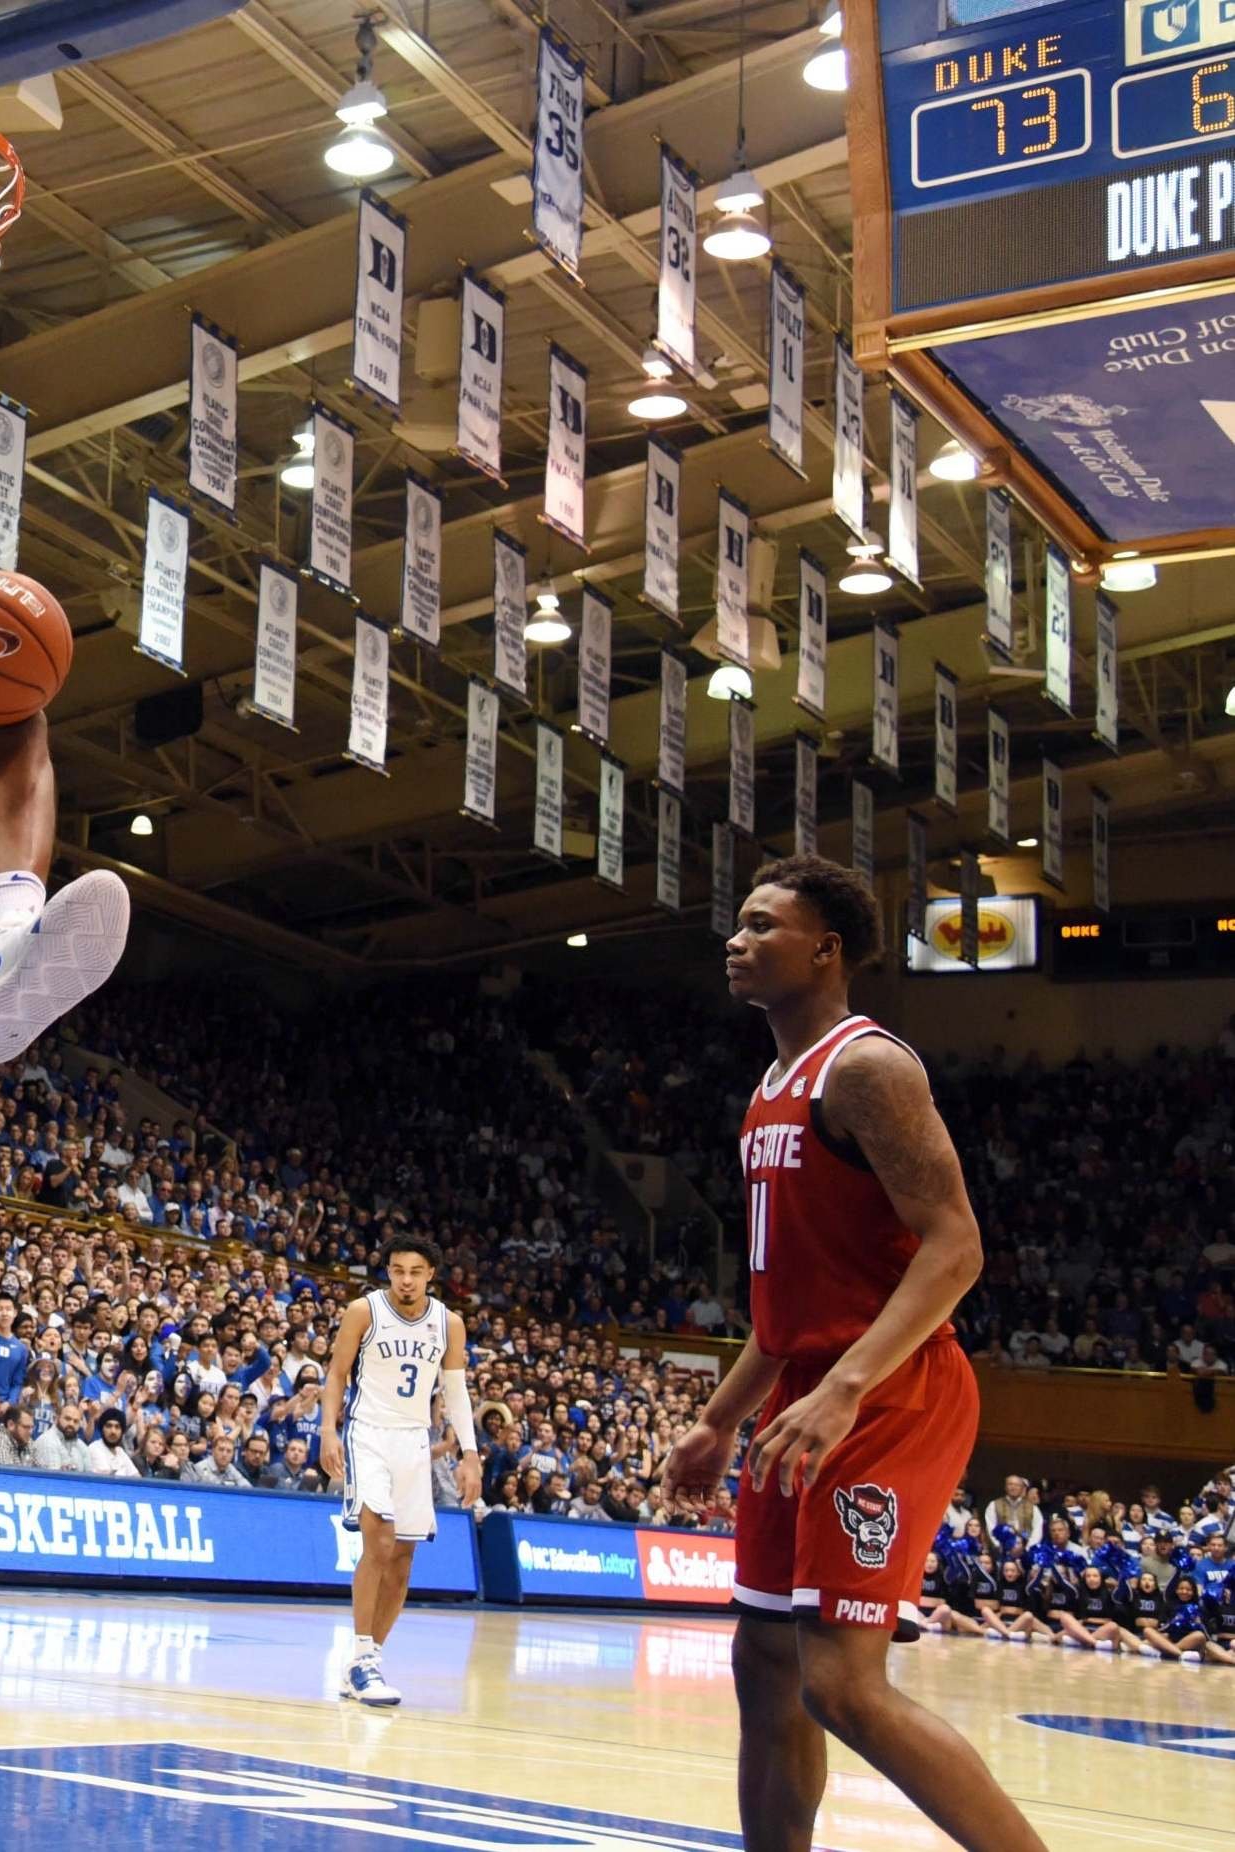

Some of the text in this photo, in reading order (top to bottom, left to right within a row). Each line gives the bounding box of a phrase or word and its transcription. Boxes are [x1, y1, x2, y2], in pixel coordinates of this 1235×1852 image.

[934, 33, 1063, 93] DUKE
[970, 85, 1057, 157] 73
[1107, 164, 1201, 263] DUKE
[1109, 327, 1187, 353] Club
[1103, 347, 1194, 373] Duke
[1061, 924, 1100, 938] DUKE
[750, 1123, 805, 1170] STATE
[375, 1339, 442, 1365] DUKE
[396, 1363, 418, 1399] 3
[835, 1598, 888, 1625] PACK
